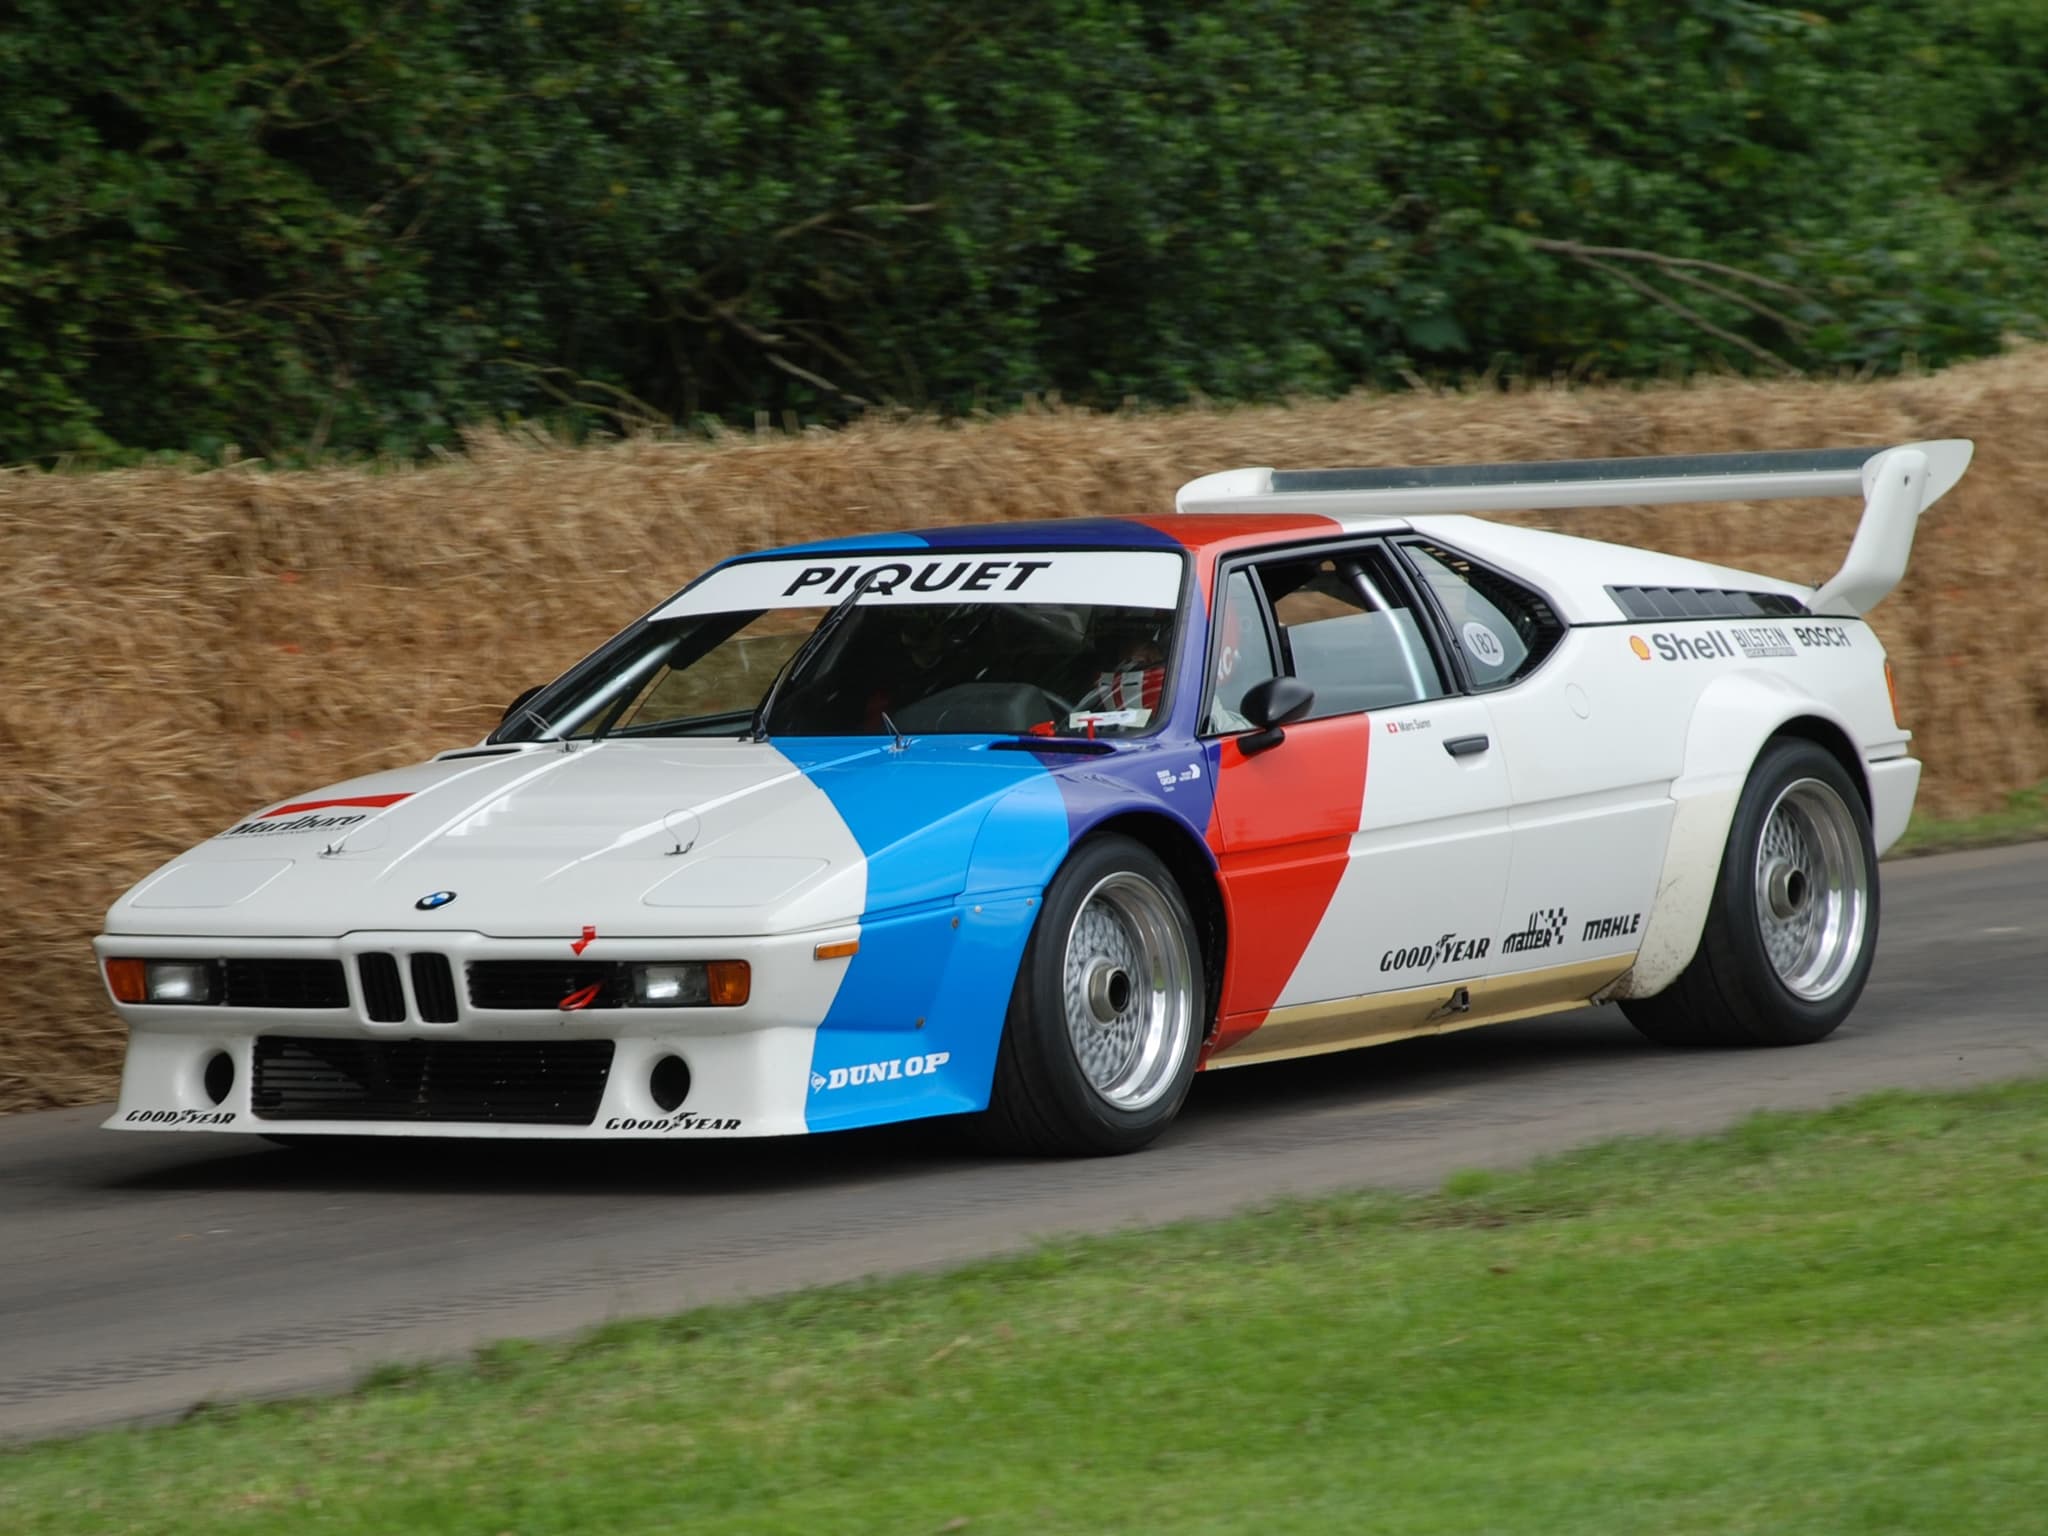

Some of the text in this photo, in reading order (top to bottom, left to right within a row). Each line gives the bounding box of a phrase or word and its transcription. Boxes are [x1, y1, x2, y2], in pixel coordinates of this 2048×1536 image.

[781, 560, 1053, 597] PIQUET
[1469, 632, 1498, 655] 182
[1652, 630, 1735, 661] Shell
[1730, 627, 1791, 649] BILSTEIN
[1793, 626, 1851, 648] BOSCH
[223, 814, 367, 835] Marlboro
[1582, 913, 1641, 942] MAHLE
[827, 1052, 950, 1090] DUNLOP
